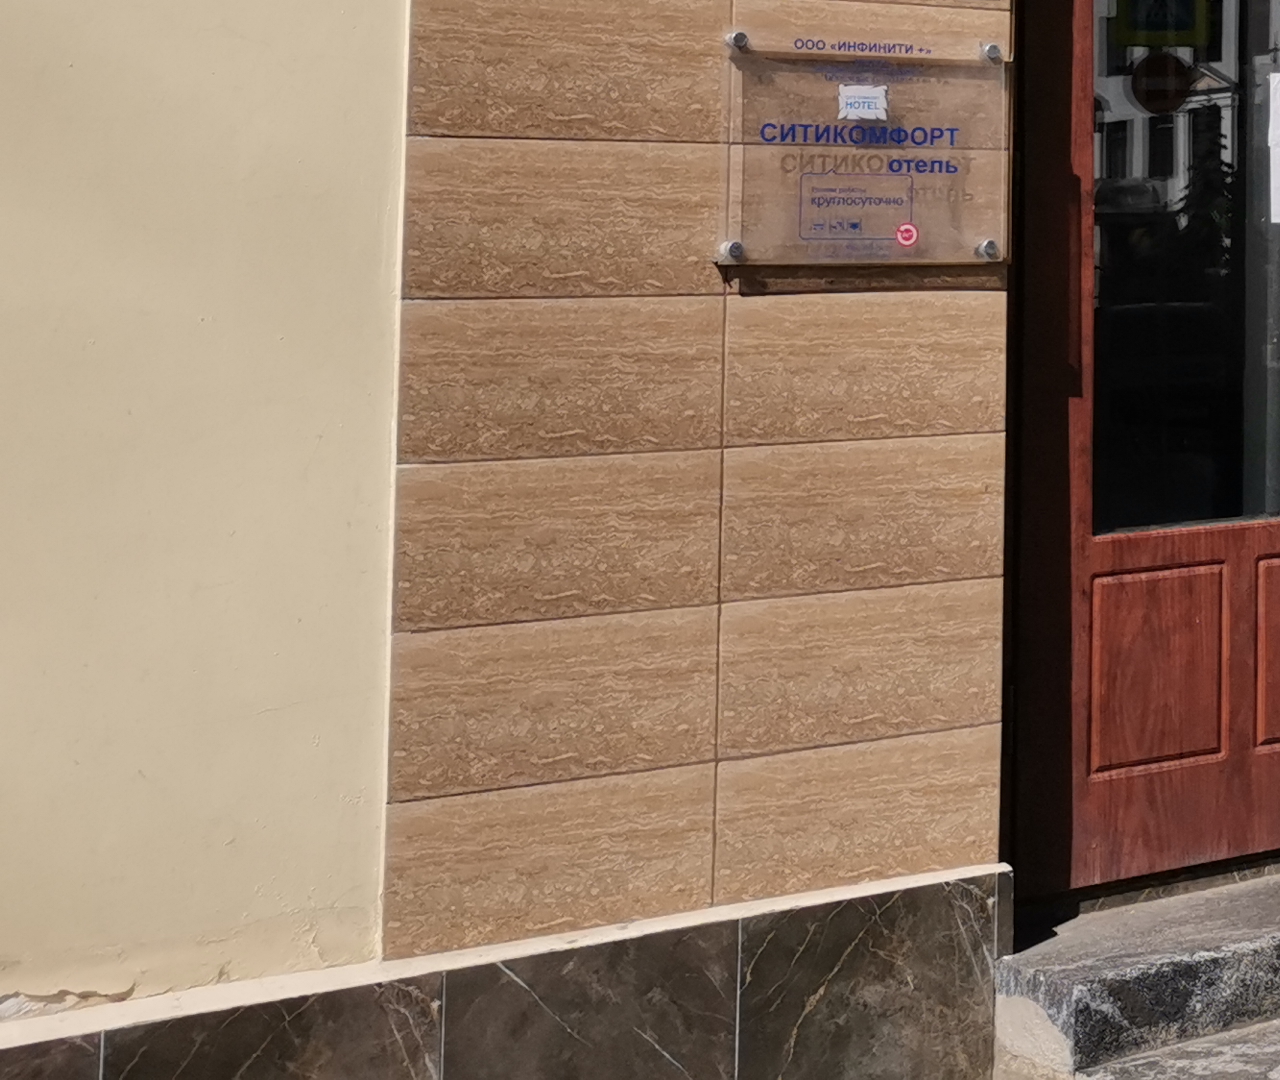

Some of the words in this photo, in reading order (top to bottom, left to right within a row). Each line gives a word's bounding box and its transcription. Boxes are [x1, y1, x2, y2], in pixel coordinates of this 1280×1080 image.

[794, 39, 826, 51] ООО
[830, 41, 914, 55] «ИНФИНИТИ
[845, 101, 880, 110] HOTEL
[760, 122, 960, 146] СИТИКОМФОРТ
[888, 158, 959, 174] отель
[811, 196, 905, 208] круглосуточно
